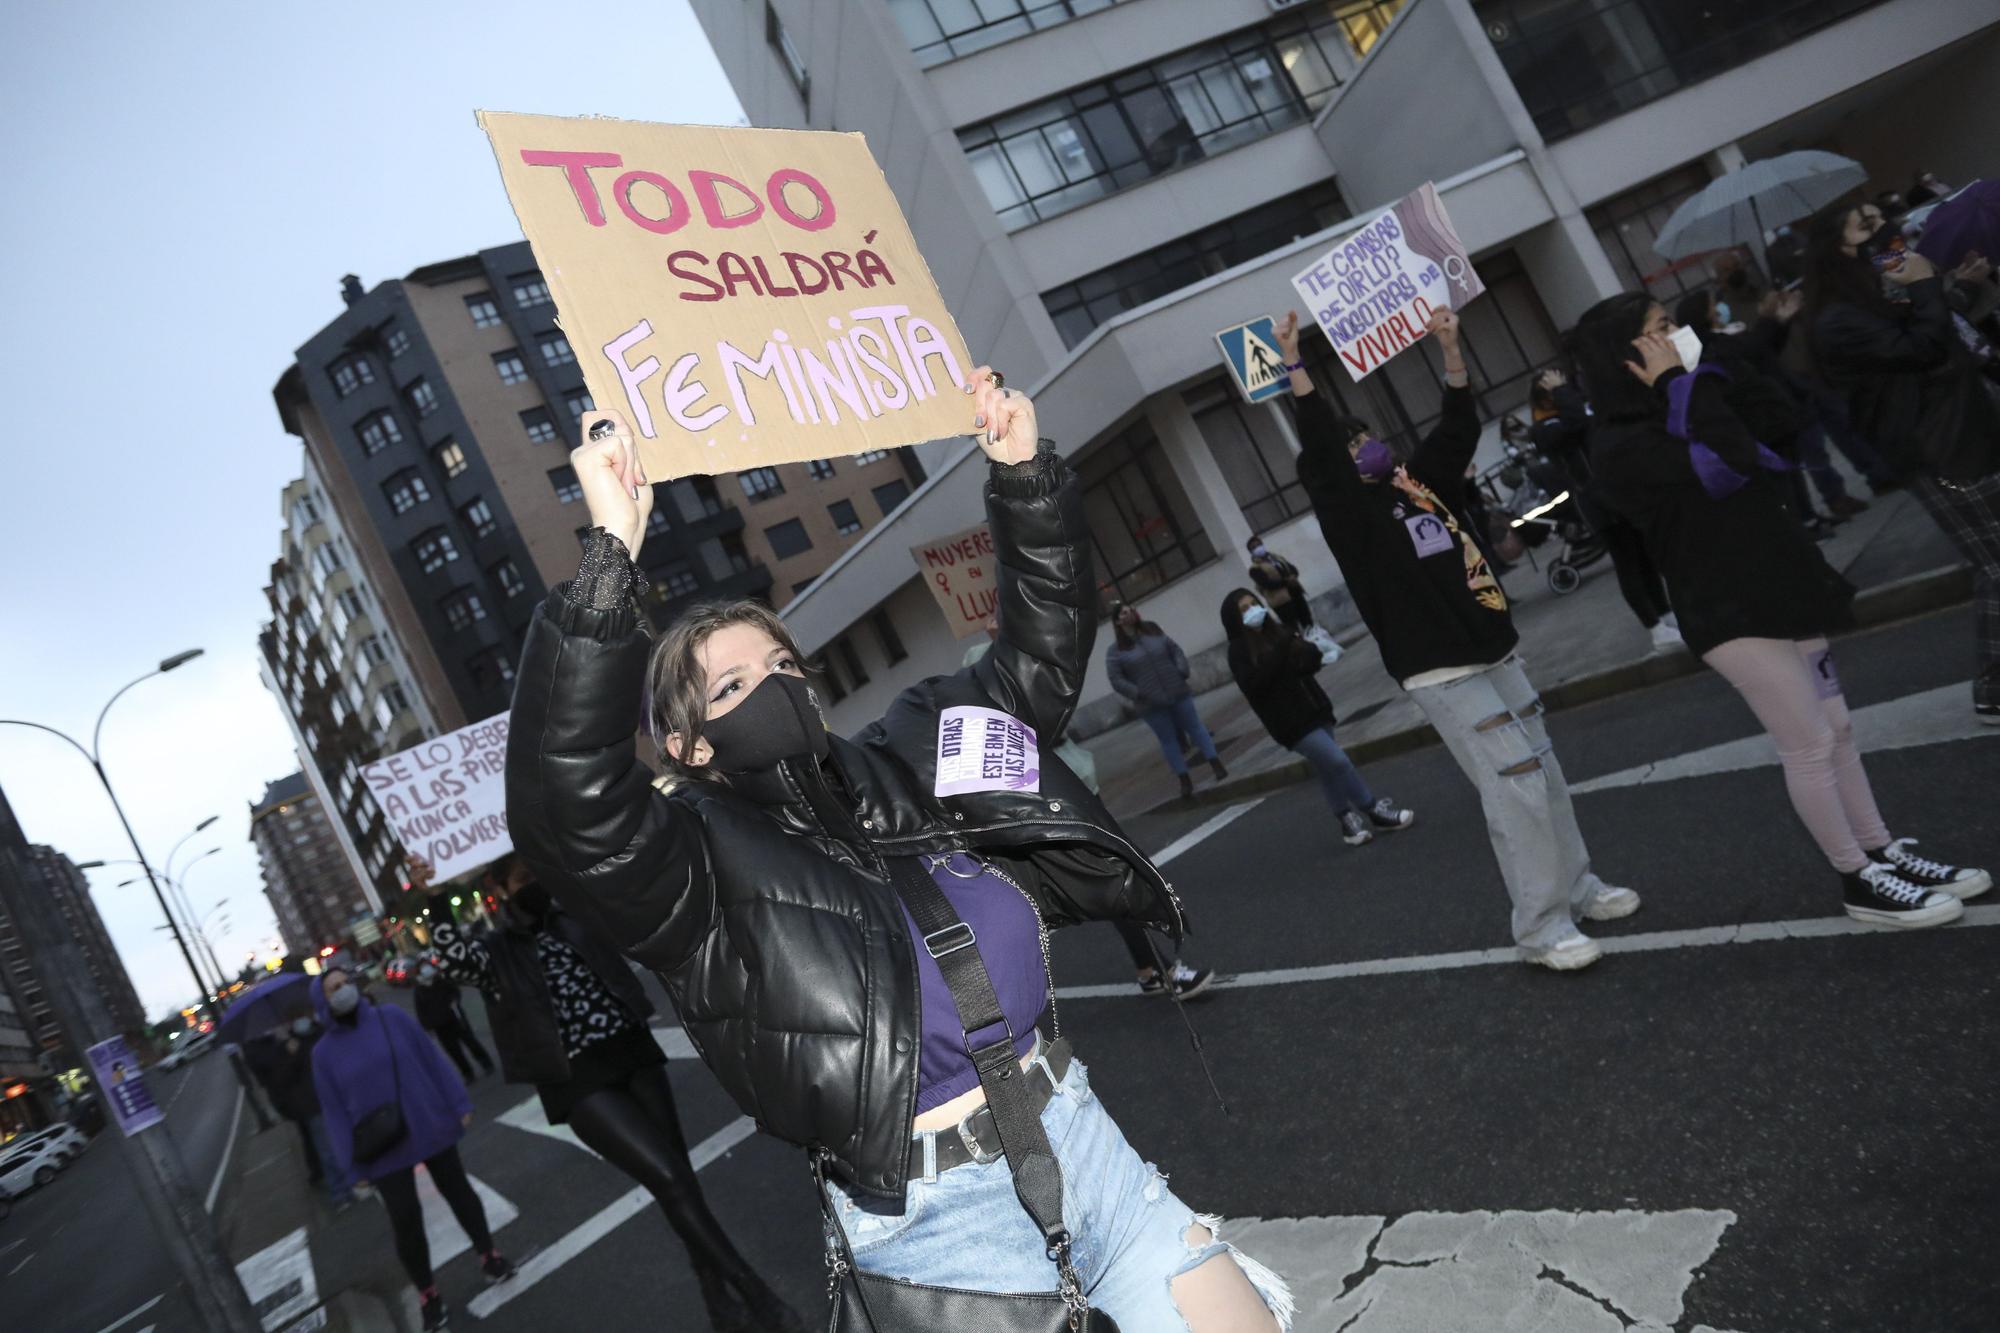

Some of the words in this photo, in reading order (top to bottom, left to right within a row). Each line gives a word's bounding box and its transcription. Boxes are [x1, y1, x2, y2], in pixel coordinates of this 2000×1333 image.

[519, 148, 837, 235] TODO
[667, 229, 896, 302] SALDRÁ
[1298, 262, 1335, 297] TE
[1332, 214, 1401, 277] CANSAS
[1319, 299, 1345, 326] DE
[1337, 244, 1400, 302] OIRLO?
[1328, 271, 1418, 348] NOSOTRAS
[1419, 263, 1441, 288] DE
[1341, 296, 1434, 373] VIVIRLO
[602, 305, 966, 439] FEMINISTA
[967, 567, 983, 579] EN
[985, 733, 1005, 750] 8M
[986, 717, 1006, 732] EN
[1006, 724, 1025, 758] CALLES
[363, 757, 413, 791] SE
[411, 743, 452, 773] LO
[982, 752, 1003, 779] ESTE
[1004, 758, 1025, 778] LAS
[385, 793, 410, 821] A
[408, 769, 467, 811] LAS
[398, 799, 473, 846] NUNCA
